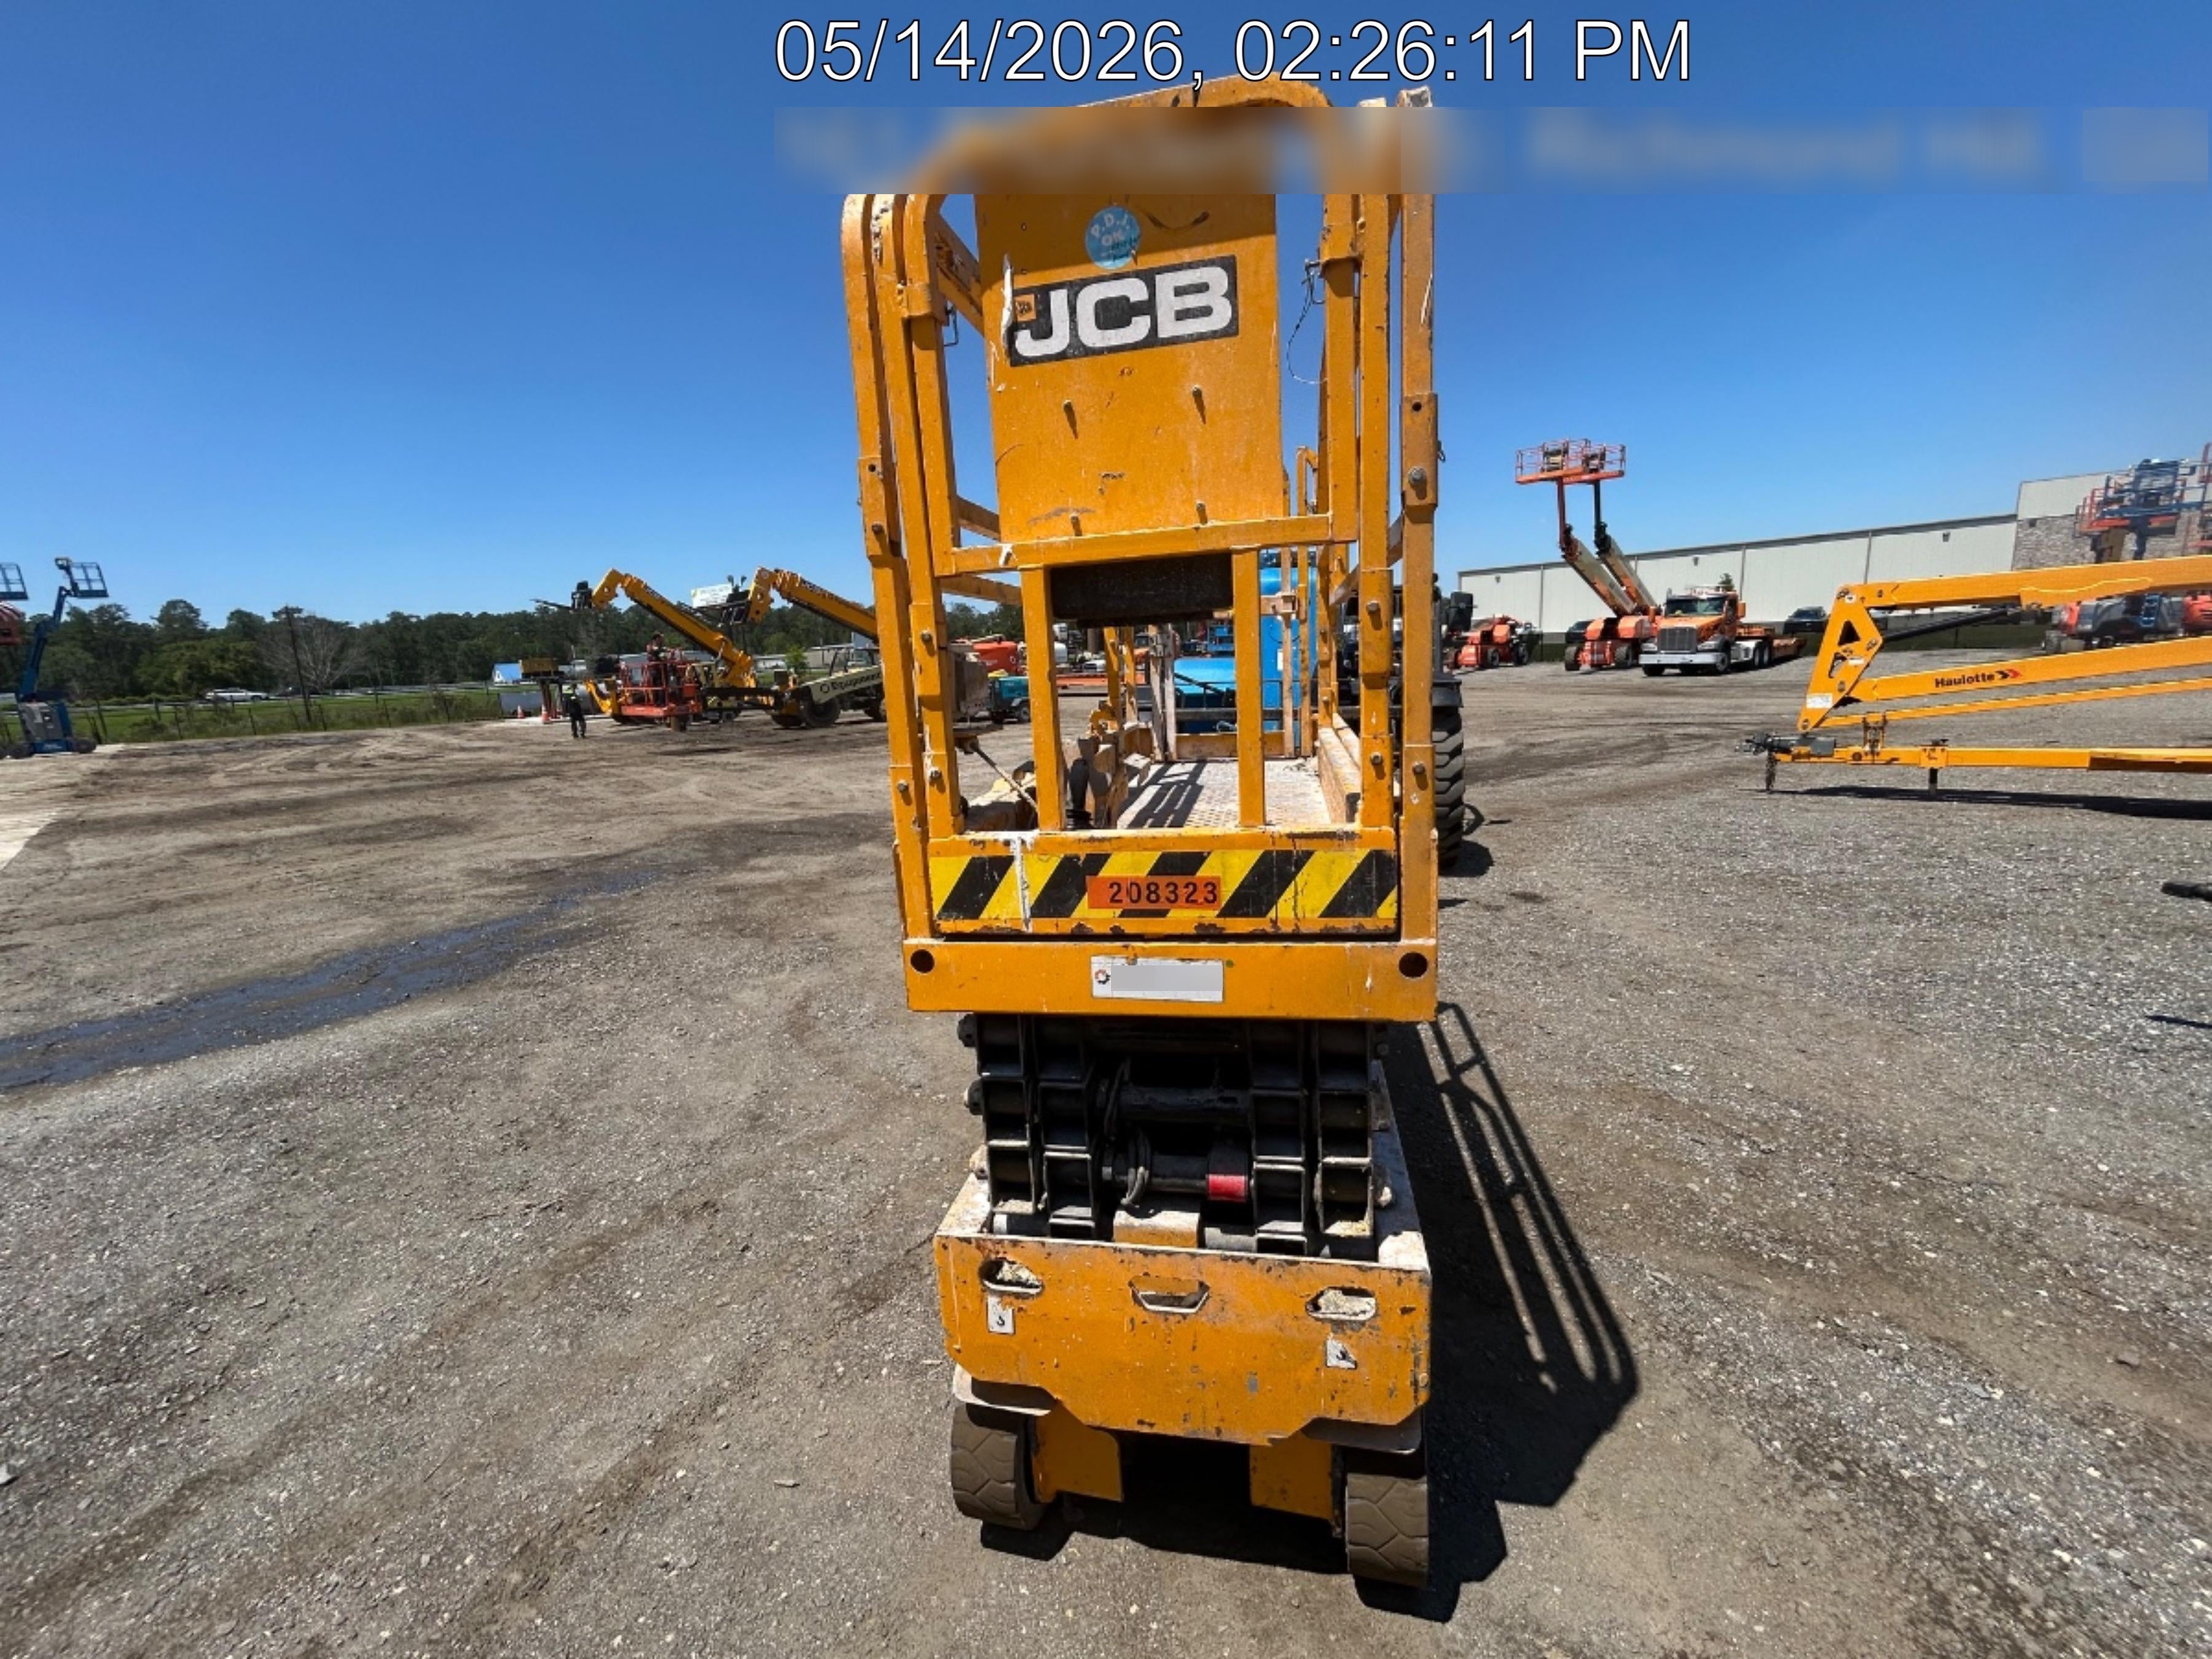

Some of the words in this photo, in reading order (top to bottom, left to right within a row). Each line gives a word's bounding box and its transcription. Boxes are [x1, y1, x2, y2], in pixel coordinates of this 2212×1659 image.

[1015, 266, 1232, 357] JCB
[1935, 672, 1995, 688] Haulotte
[1108, 880, 1217, 904] 208323
